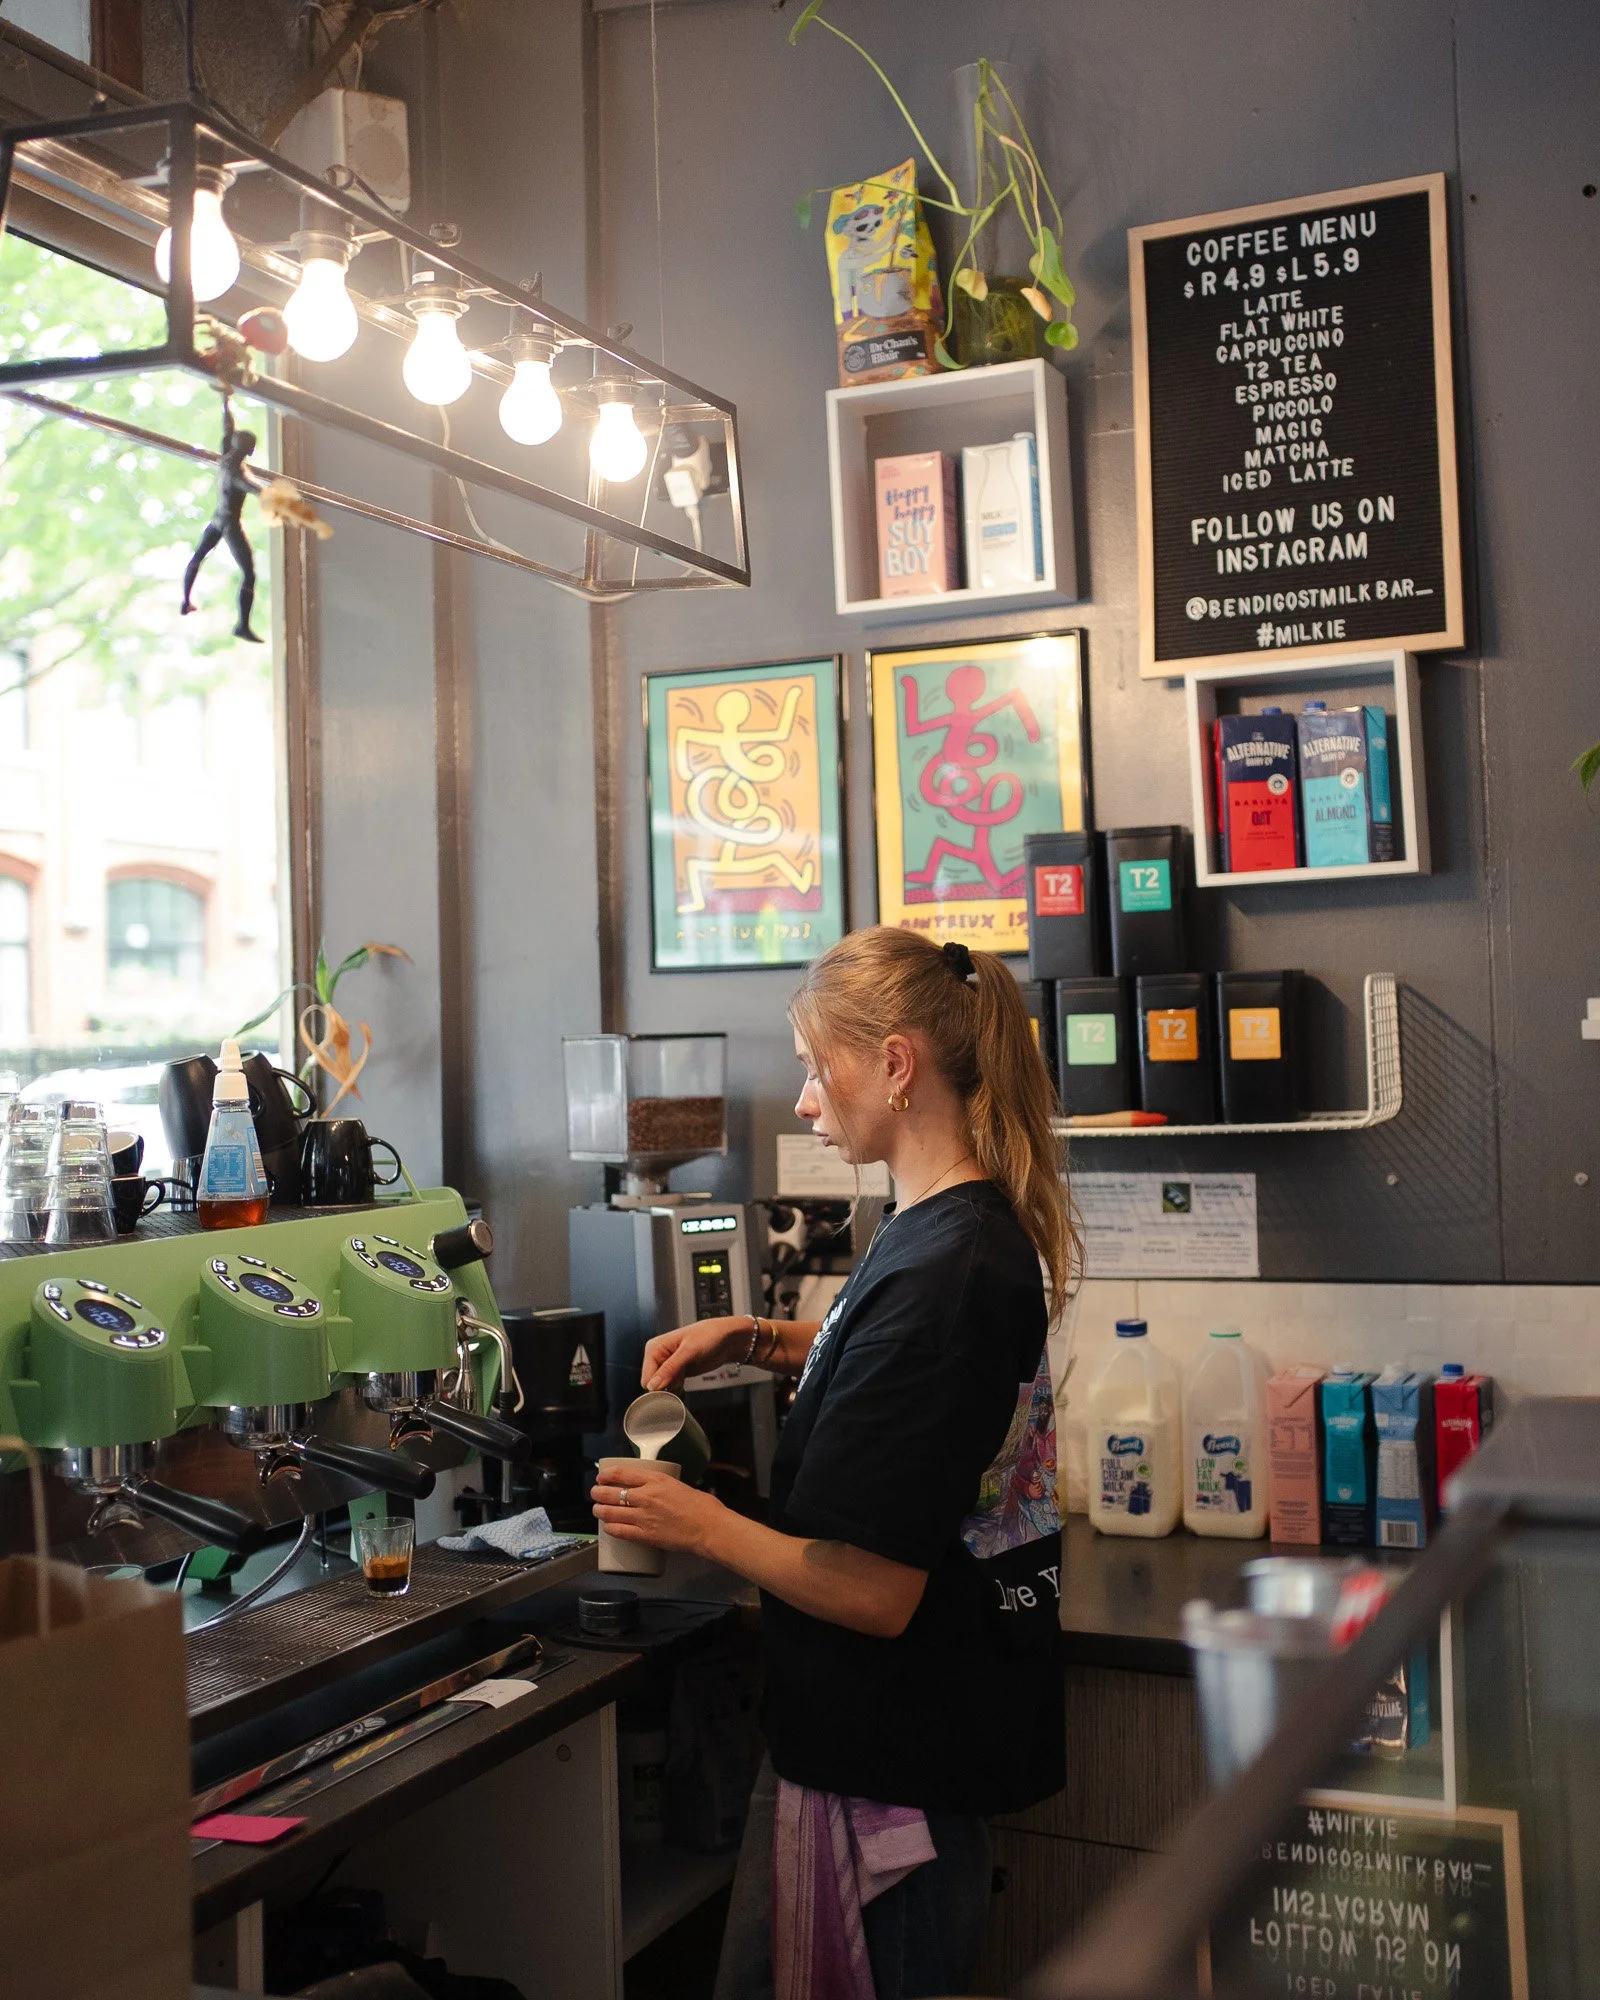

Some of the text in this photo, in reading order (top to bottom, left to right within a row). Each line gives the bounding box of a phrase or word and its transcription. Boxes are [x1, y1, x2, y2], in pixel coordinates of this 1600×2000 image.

[1186, 210, 1377, 267] COFFEE MENU
[1243, 289, 1304, 316] LATTE
[1220, 305, 1345, 342] FLAT WHITE
[1215, 327, 1345, 365] CAPPUCCINO
[1245, 352, 1322, 381] T2 TEA
[1235, 372, 1337, 405] ESPRESSO
[1252, 395, 1334, 424] PICCOLO
[1255, 418, 1323, 446] MAGIC
[1244, 440, 1330, 469] MATCHA
[1222, 457, 1355, 494] ICED LATTE
[886, 485, 929, 506] Happy
[894, 504, 935, 523] happy
[1191, 495, 1396, 546] FOLLOW US ON
[884, 544, 934, 578] BOY
[1216, 531, 1369, 575] INSTAGRAM
[1256, 619, 1347, 648] #MILKIE
[1226, 741, 1291, 763] ALTERNATIVE
[1302, 735, 1362, 760] ALTERNATIVE
[1234, 798, 1288, 807] BARISTA
[1315, 804, 1357, 823] ALMOND
[1251, 810, 1272, 826] OAT
[1043, 873, 1073, 896] T2
[1129, 867, 1160, 889] T2
[1008, 911, 1028, 927] 19
[1077, 1021, 1106, 1043] T2
[1159, 1018, 1187, 1040] T2
[1239, 1016, 1270, 1039] T2
[1101, 1458, 1122, 1470] FULL
[1102, 1469, 1134, 1481] CREAM
[1196, 1458, 1216, 1470] LOW
[1197, 1469, 1212, 1481] FAT
[1103, 1481, 1126, 1493] MILK
[1198, 1481, 1221, 1493] MILK
